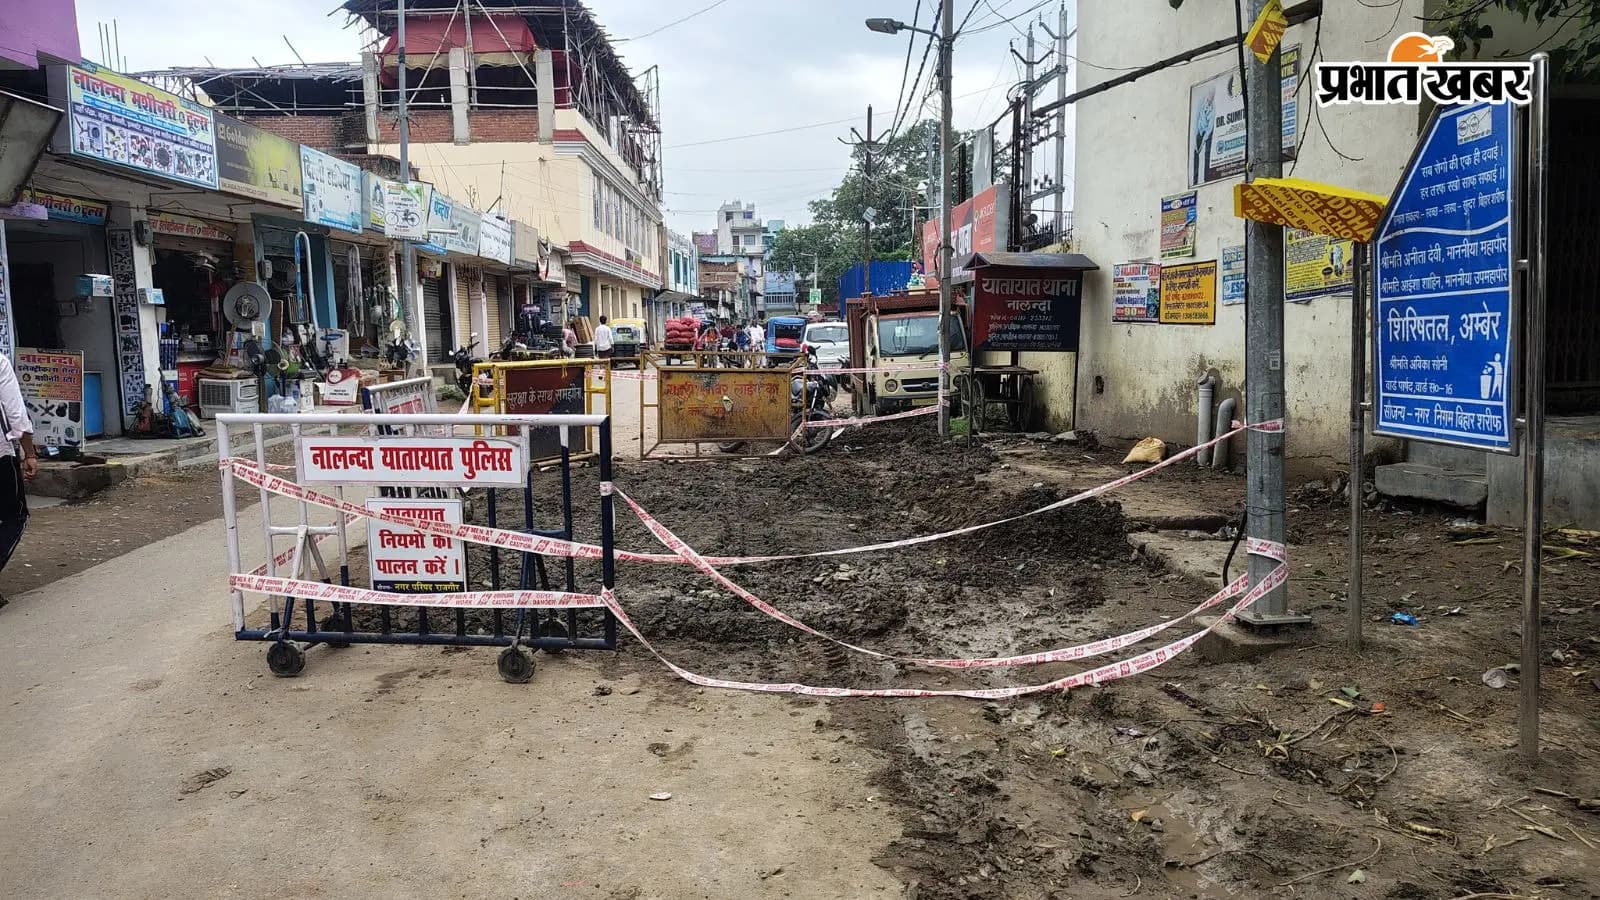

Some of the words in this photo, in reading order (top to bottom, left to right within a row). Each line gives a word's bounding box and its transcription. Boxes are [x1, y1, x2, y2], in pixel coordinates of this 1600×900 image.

[1421, 165, 1433, 178] सब
[1449, 154, 1459, 170] की
[1460, 154, 1472, 171] एक
[1473, 148, 1481, 165] ही
[1481, 141, 1499, 160] दवाई
[1420, 187, 1429, 200] हर
[1447, 176, 1460, 192] रखो
[1243, 189, 1269, 213] Mob
[1294, 201, 1303, 209] to
[1286, 207, 1298, 219] for
[1404, 246, 1426, 266] अनीता
[1445, 238, 1479, 259] माननीया
[1480, 233, 1507, 256] महापौर
[1445, 268, 1473, 287] माननीया
[1474, 264, 1508, 284] उपमहापौर
[982, 278, 1042, 296] यातायात
[1042, 279, 1078, 297] थाना
[1006, 300, 1052, 314] नालन्दा
[1459, 301, 1501, 341] अम्बेर
[19, 353, 74, 365] नालन्दा
[1432, 354, 1448, 370] सोनी
[507, 391, 528, 410] सुरक्षा
[528, 387, 537, 404] के
[537, 389, 554, 404] साथ
[1384, 400, 1406, 421] सौजन्य
[1414, 407, 1431, 424] नगर
[1434, 403, 1454, 428] निगम
[1455, 405, 1476, 431] बिहार
[1476, 407, 1502, 433] शरीफ
[310, 445, 374, 470] नालन्दा
[379, 445, 454, 471] यातायात
[459, 440, 513, 479] पुलिस
[470, 527, 485, 535] MEN
[485, 529, 493, 537] AT
[473, 534, 490, 542] WORK
[509, 540, 533, 549] CAUTION
[375, 559, 418, 575] पालन
[423, 555, 448, 575] करें
[394, 582, 410, 591] नगर
[434, 582, 460, 591] राजगीर
